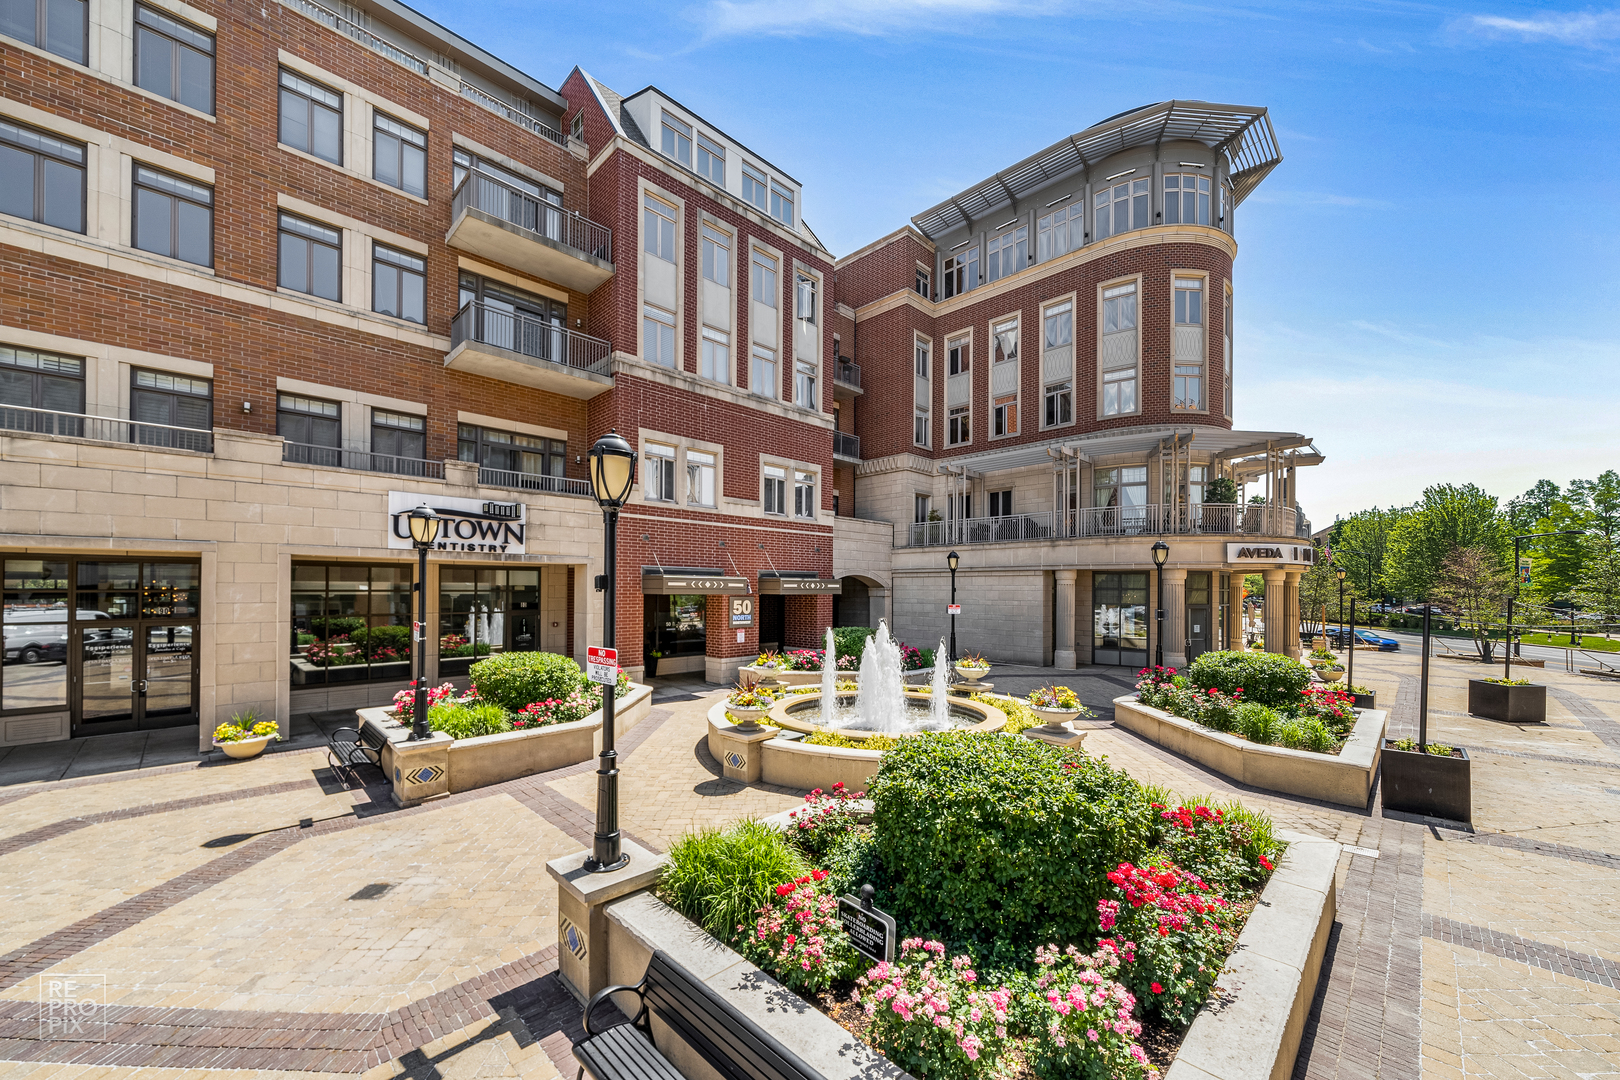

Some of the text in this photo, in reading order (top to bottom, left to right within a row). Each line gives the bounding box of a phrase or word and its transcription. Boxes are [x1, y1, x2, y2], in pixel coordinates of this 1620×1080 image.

[391, 514, 526, 545] UTOWN
[1237, 546, 1283, 559] AVEDA
[733, 599, 751, 615] 50
[588, 655, 616, 666] TRESPASSING
[840, 911, 884, 939] SKATEBOARDING
[858, 914, 866, 922] NO
[849, 929, 874, 946] ALLOWED
